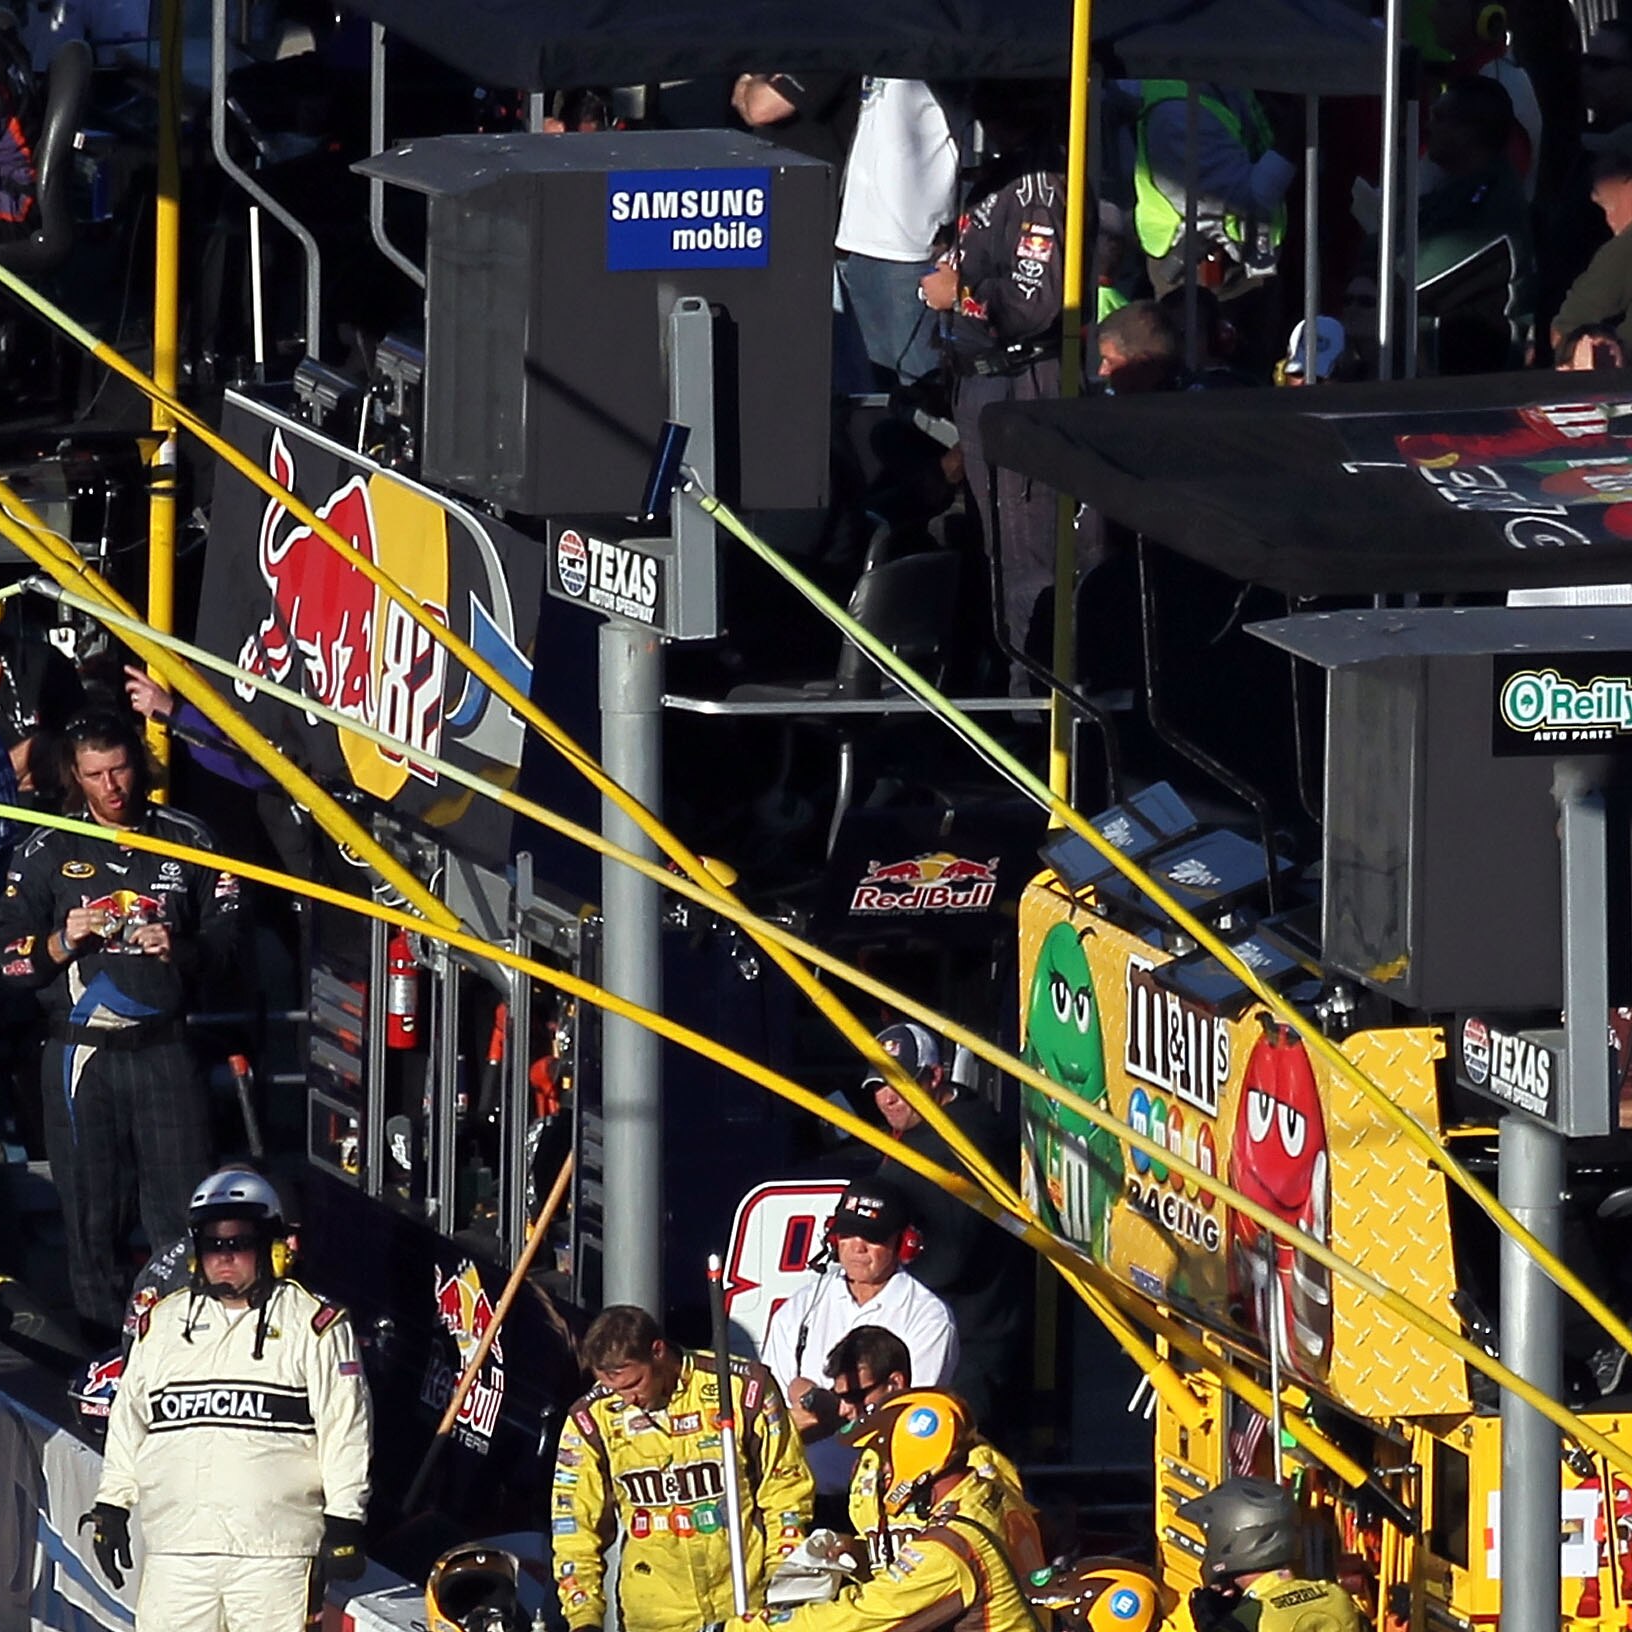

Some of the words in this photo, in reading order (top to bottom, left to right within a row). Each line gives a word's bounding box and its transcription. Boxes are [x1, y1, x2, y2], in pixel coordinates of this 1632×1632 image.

[611, 190, 764, 221] SAMSUNG
[672, 221, 764, 252] mobile
[587, 538, 658, 606] TEXAS
[1533, 730, 1568, 743] AUTO
[1571, 729, 1614, 742] PARTS
[850, 886, 922, 910] Red
[923, 882, 996, 909] Bull
[1489, 1029, 1550, 1098] TEXAS
[160, 1390, 272, 1422] OFFICIAL
